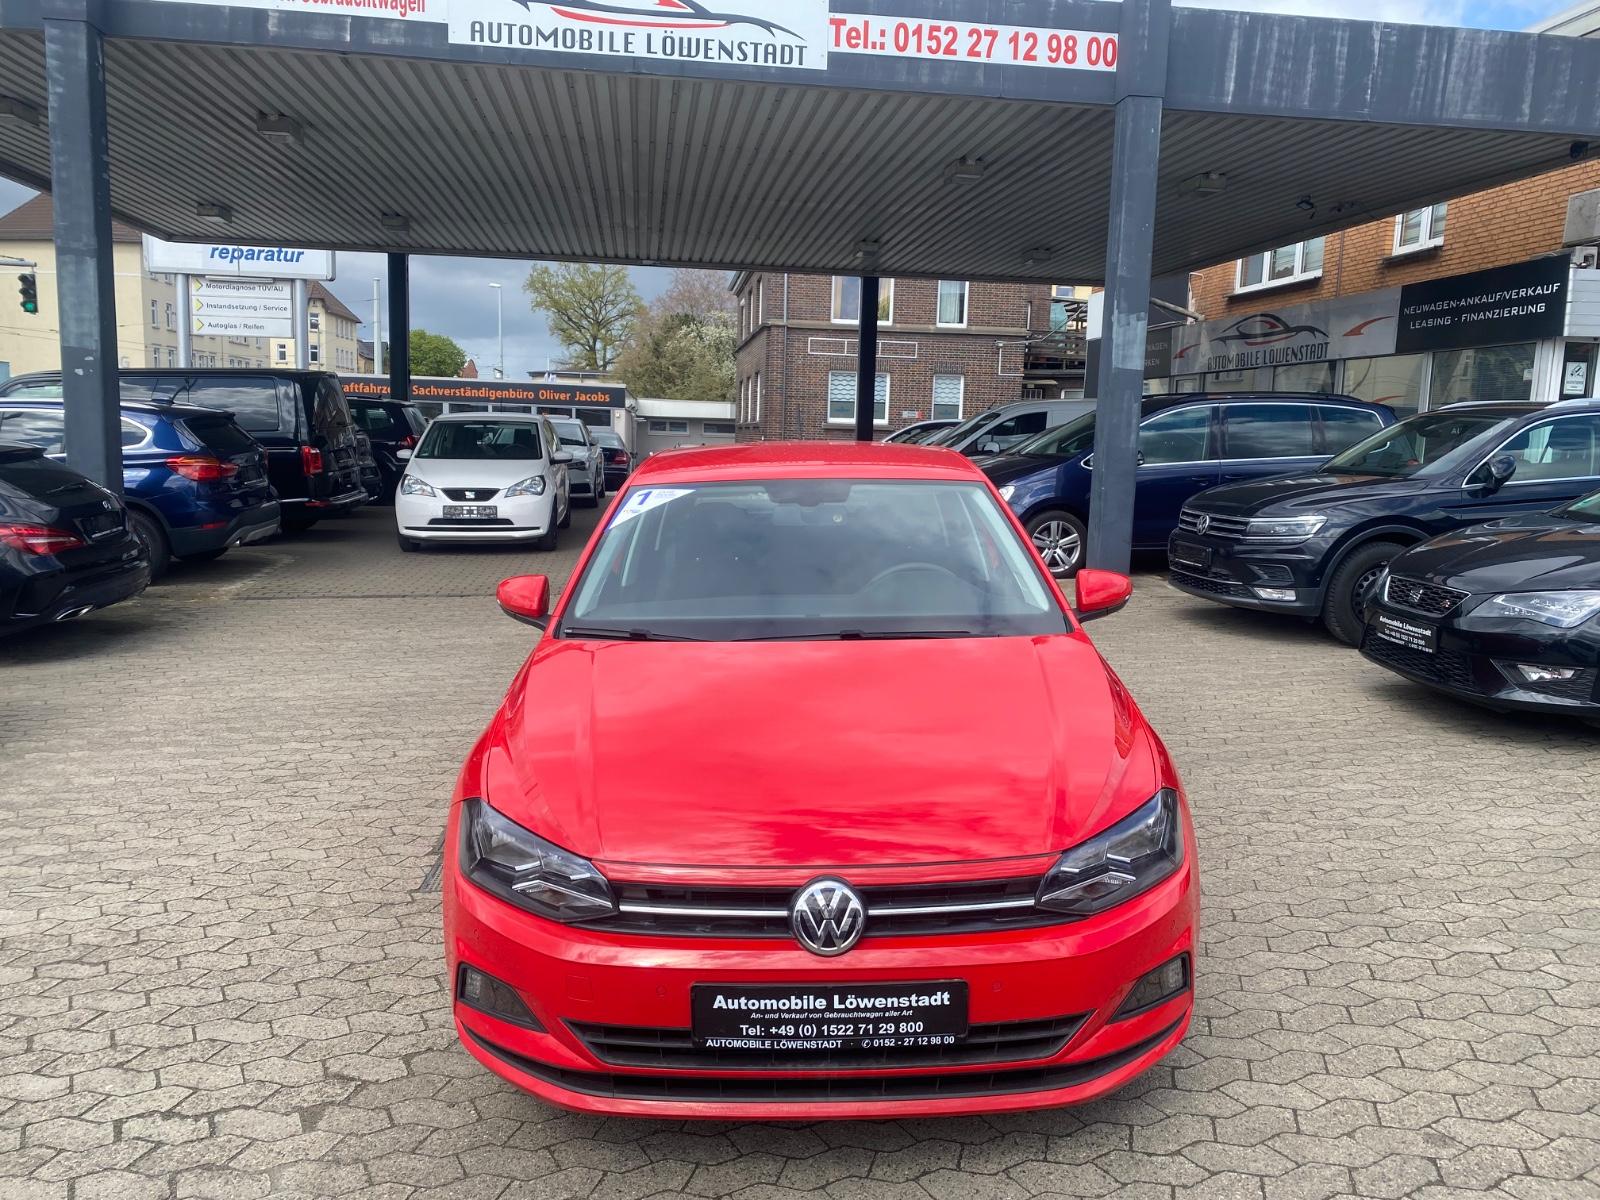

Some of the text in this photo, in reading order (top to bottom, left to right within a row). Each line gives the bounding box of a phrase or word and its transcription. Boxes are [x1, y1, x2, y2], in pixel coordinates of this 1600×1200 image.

[470, 20, 808, 66] AUTOMOBILE LÖWENSTADT
[829, 17, 1117, 68] Tel.: 0152 27 12 98 00
[209, 246, 305, 264] reparatur
[206, 283, 256, 292] Motordiagnose
[206, 302, 258, 312] Instandsetzung
[264, 303, 289, 312] Service
[1403, 283, 1561, 315] NEUWAGEN-ANKAUF/VERKAUF
[1410, 316, 1452, 329] LEASING
[1461, 302, 1546, 323] FINANZIERUNG
[243, 323, 265, 332] Reifen
[1207, 351, 1260, 371] AUTOMOBILE
[412, 384, 535, 401] Sachverständigenbüro
[539, 389, 572, 401] Oliver
[575, 391, 611, 402] Jacobs
[713, 991, 951, 1010] Automobile Löwenstadt
[823, 1011, 883, 1020] Gebrauchtwagen
[884, 1010, 901, 1018] aller
[740, 1022, 923, 1037] Tel: +49 (0) 1522 71 29 800
[706, 1040, 772, 1049] AUTOMOBILE
[774, 1040, 842, 1049] LÖWENSTADT
[873, 1039, 895, 1047] 0152
[904, 1038, 915, 1046] 27
[917, 1037, 928, 1045] 12
[930, 1036, 941, 1045] 98
[943, 1036, 954, 1044] 00
